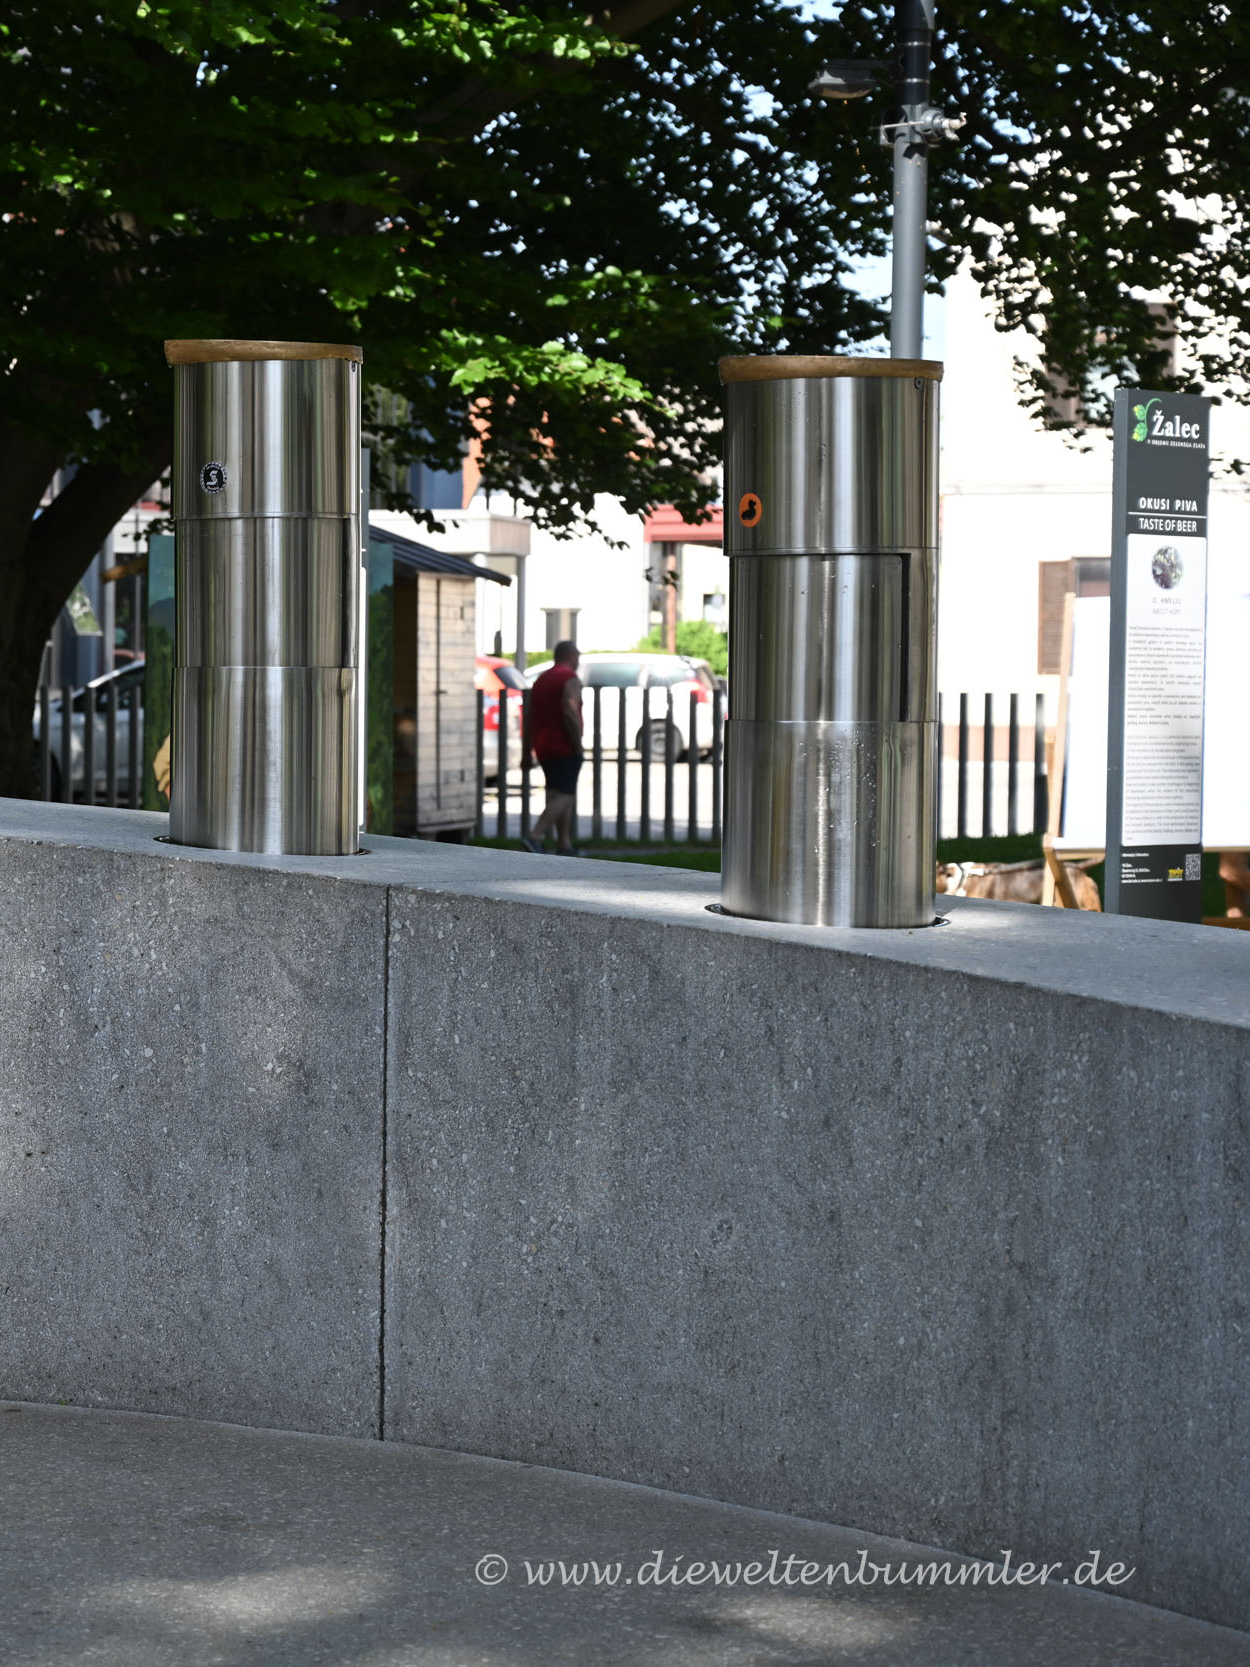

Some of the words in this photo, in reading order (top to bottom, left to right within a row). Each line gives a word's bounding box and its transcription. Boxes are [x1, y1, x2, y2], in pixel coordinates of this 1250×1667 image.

[1152, 409, 1200, 439] Žalec
[1139, 497, 1170, 511] OKUSI
[1175, 499, 1198, 512] PIVA
[1138, 517, 1163, 531] TASTE
[1165, 519, 1176, 532] OF
[1177, 520, 1198, 532] BEER
